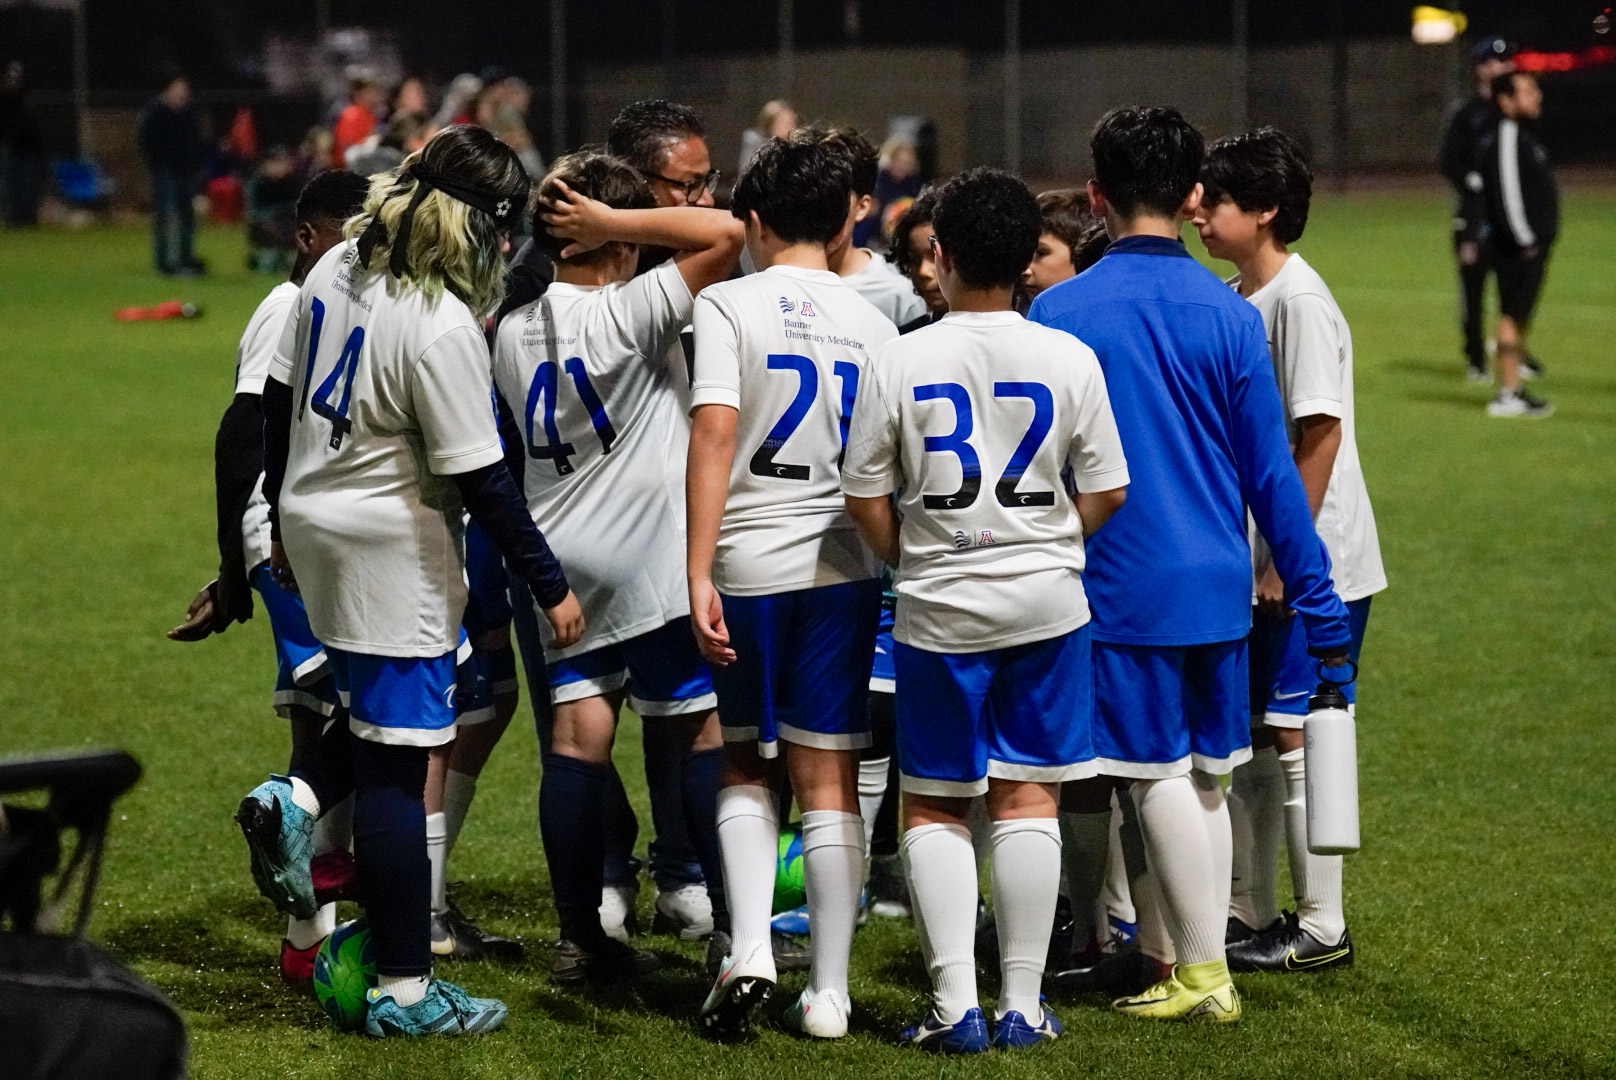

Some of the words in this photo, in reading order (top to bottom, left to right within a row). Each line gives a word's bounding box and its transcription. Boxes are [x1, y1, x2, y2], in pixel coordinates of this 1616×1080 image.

[801, 301, 816, 317] A
[784, 318, 812, 330] Banner
[784, 329, 825, 345] University
[827, 335, 865, 350] Medicine
[298, 296, 365, 451] 14
[525, 357, 617, 476] 41
[914, 382, 1055, 510] 32
[979, 530, 995, 545] A
